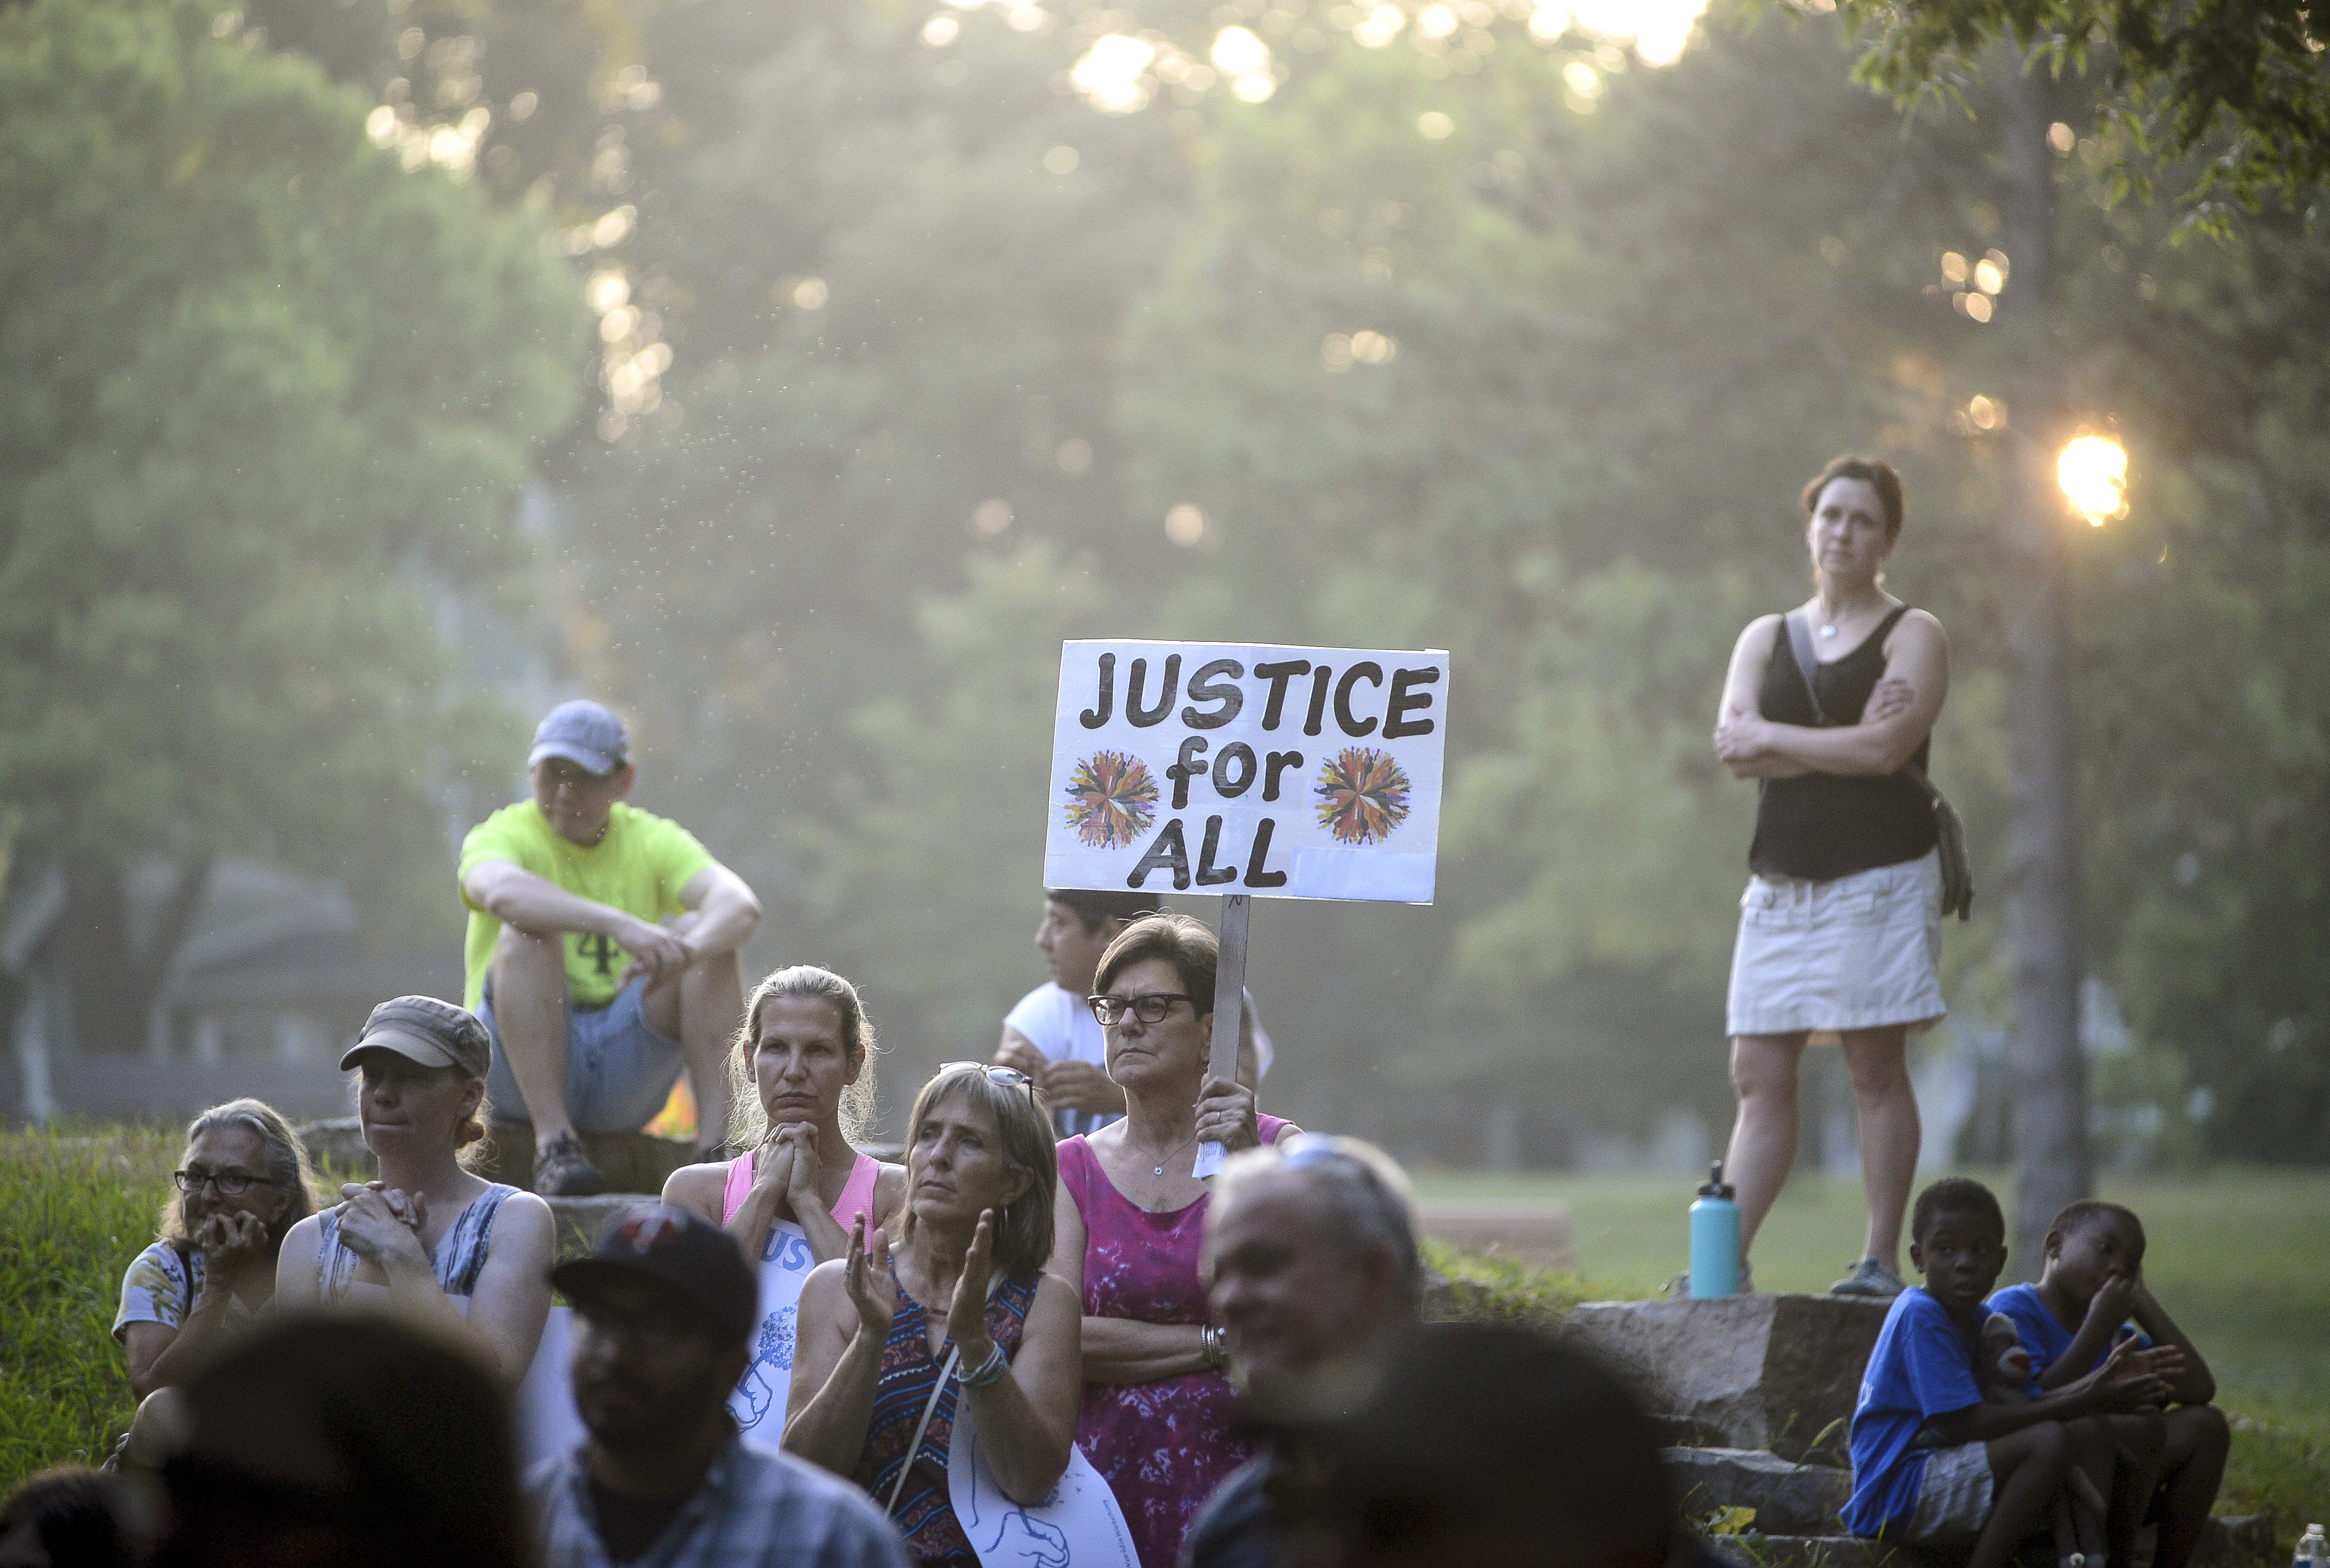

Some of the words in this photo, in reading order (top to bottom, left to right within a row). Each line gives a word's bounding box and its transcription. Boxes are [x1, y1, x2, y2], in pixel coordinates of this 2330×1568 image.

[1080, 652, 1439, 739] JUSTICE
[1165, 736, 1303, 809] for
[1127, 814, 1288, 890] ALL
[576, 932, 619, 974] 4
